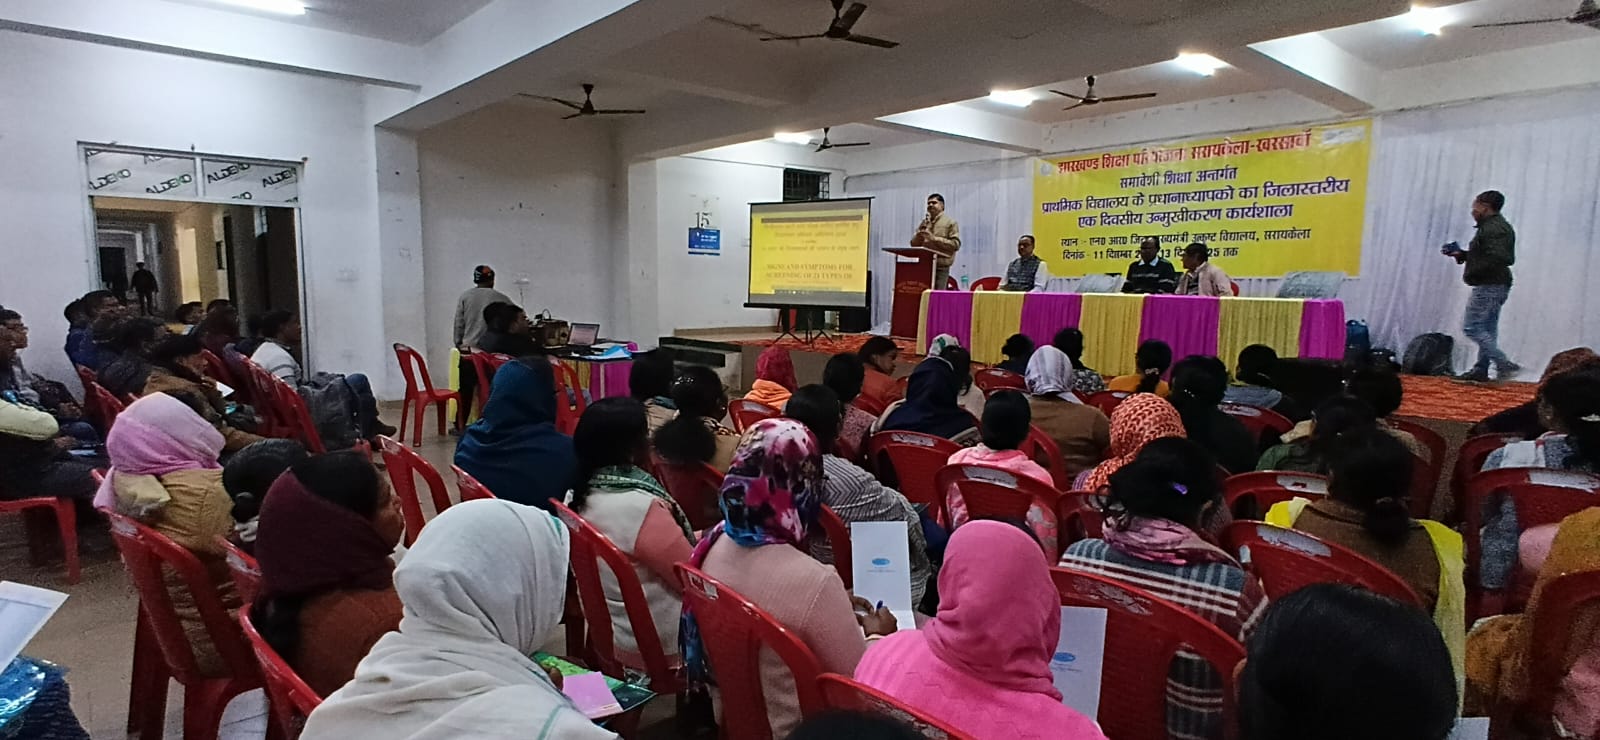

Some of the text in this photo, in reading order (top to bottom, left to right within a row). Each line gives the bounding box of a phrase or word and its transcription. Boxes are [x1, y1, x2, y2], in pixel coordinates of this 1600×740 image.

[1102, 153, 1130, 169] शिक्षा
[1120, 165, 1238, 188] समावेशी शिक्षा अन्तर्गत
[1042, 197, 1083, 213] प्राथमिक
[1086, 195, 1130, 210] विद्यालय
[1132, 192, 1145, 208] के
[1239, 186, 1258, 200] का
[1263, 175, 1350, 198] जिलास्तरीय
[1078, 201, 1293, 228] एक दिवसीय उन्मुखीकरण कार्यशाला
[1264, 226, 1311, 240] सरायकेला
[1094, 250, 1103, 260] 11
[1223, 246, 1239, 257] तक
